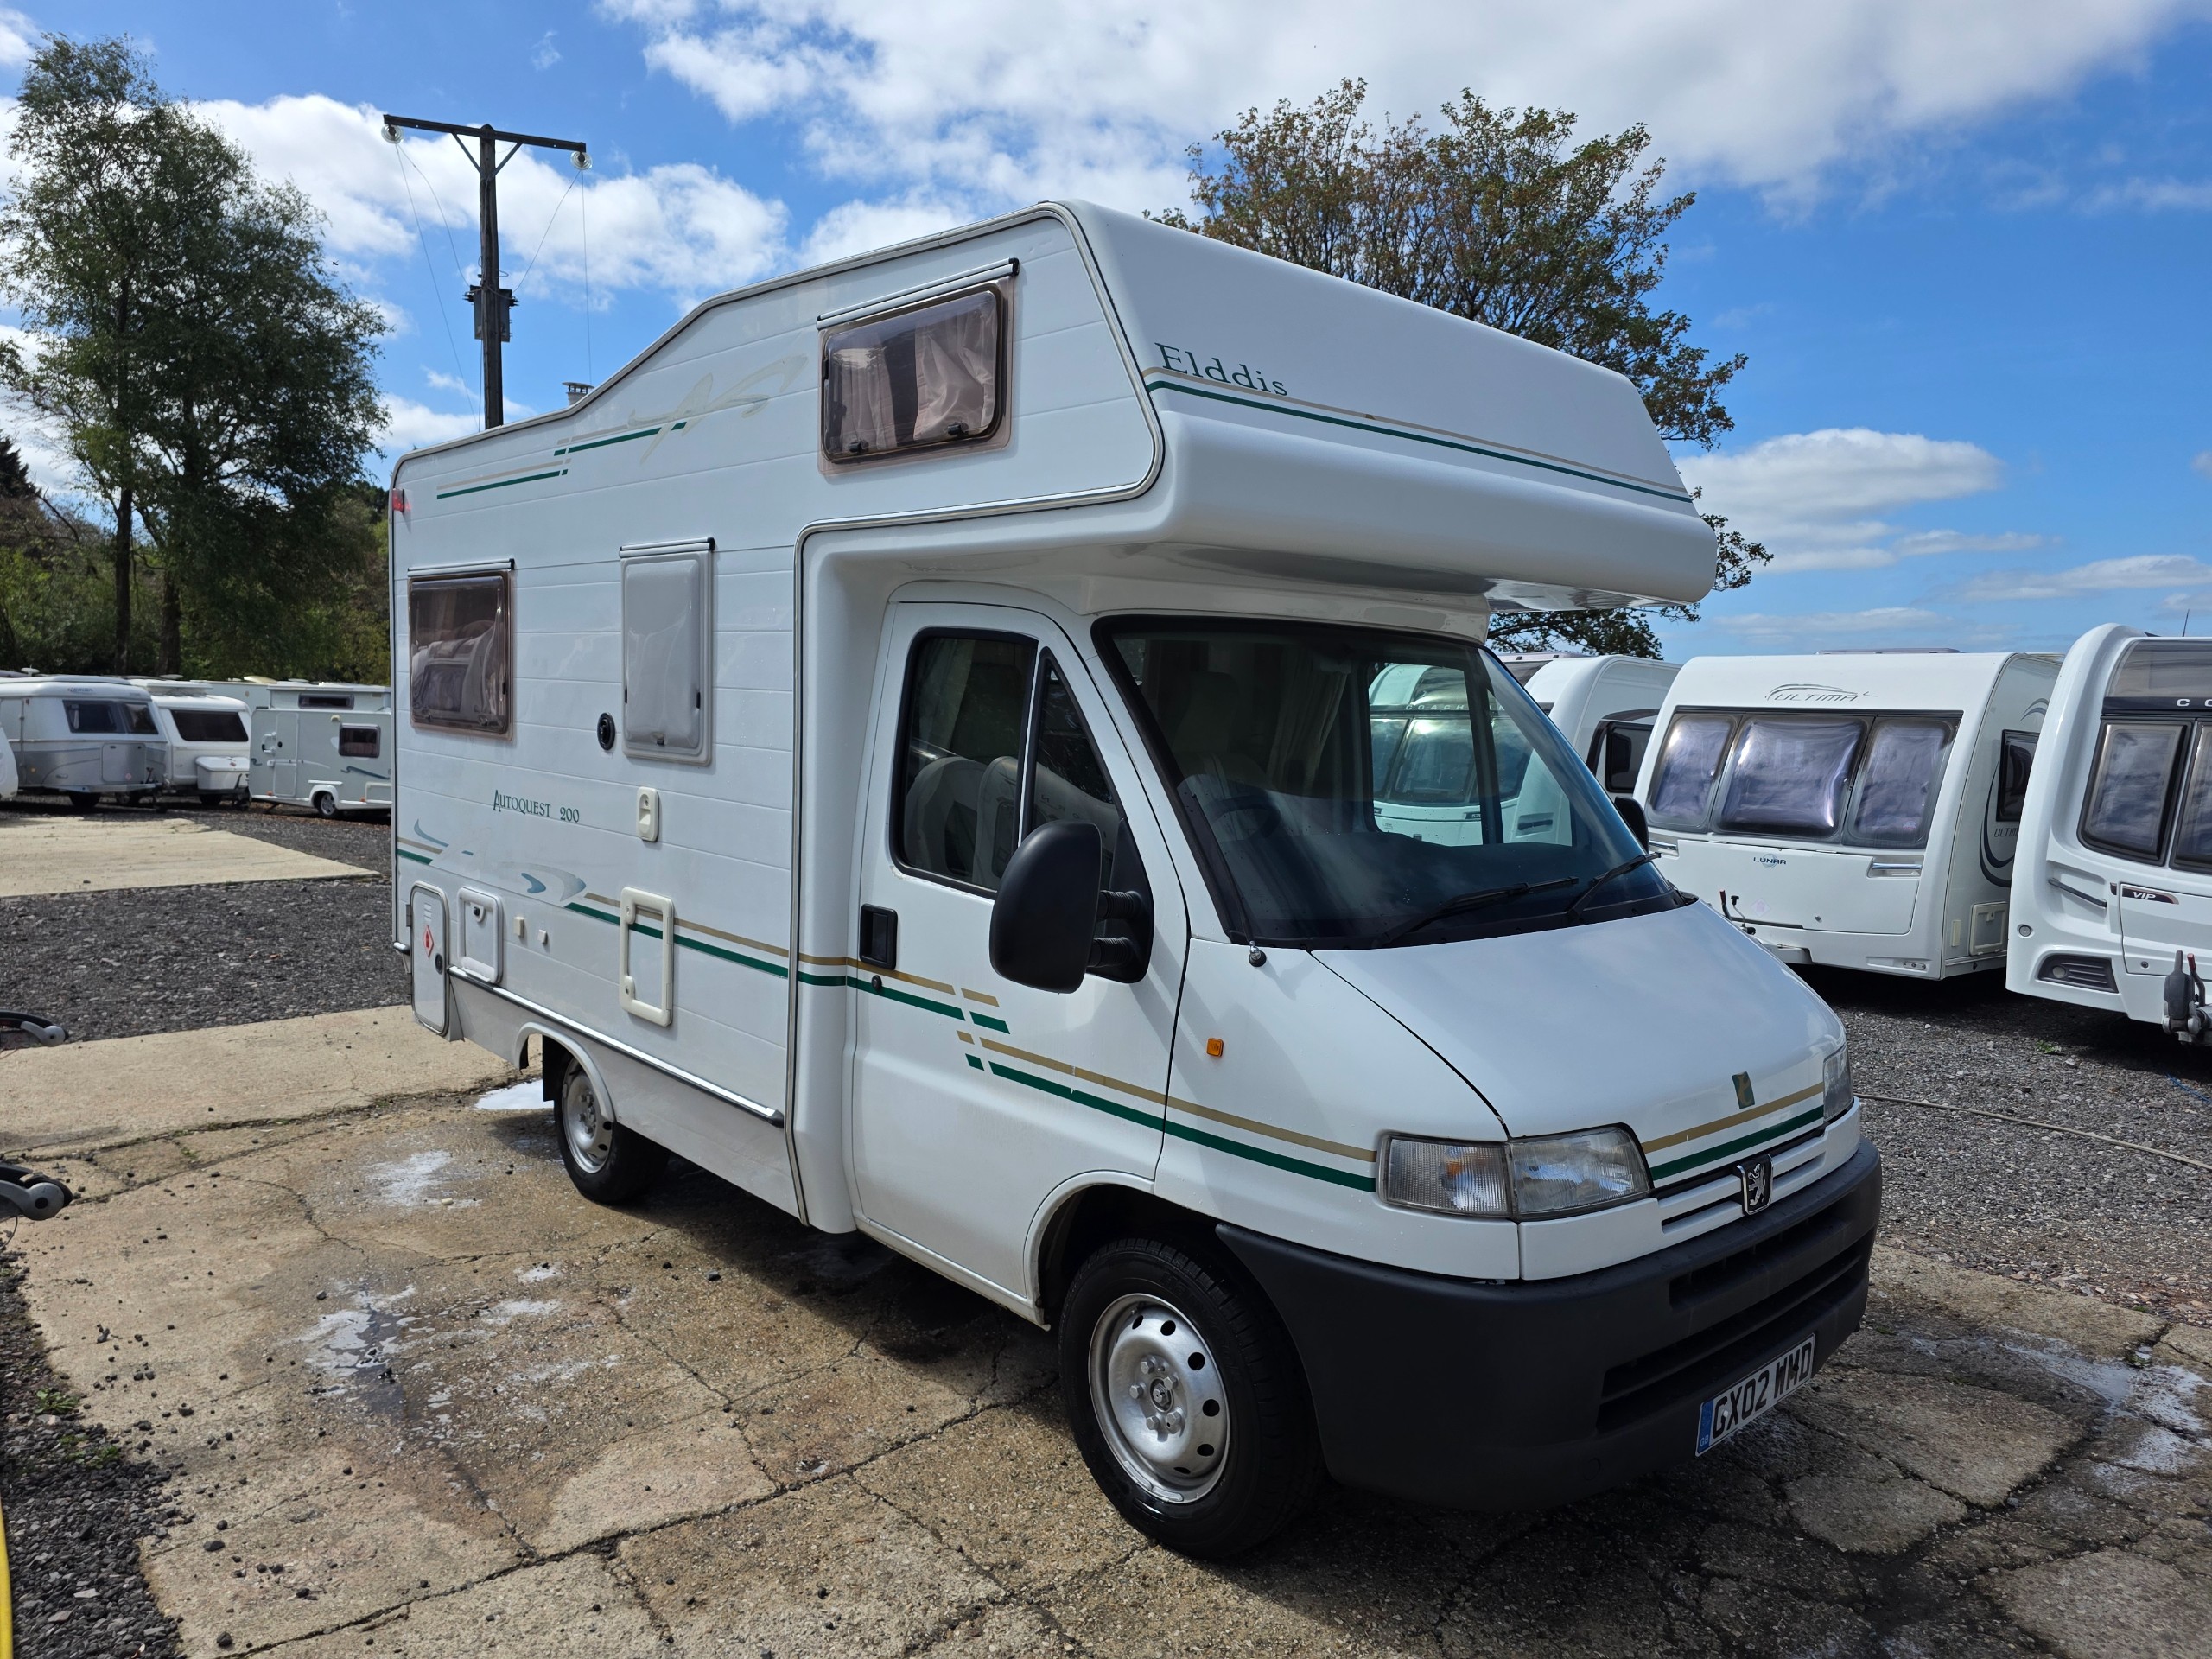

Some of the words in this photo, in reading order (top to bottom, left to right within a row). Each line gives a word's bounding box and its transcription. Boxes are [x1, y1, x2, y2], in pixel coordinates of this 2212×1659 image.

[1154, 342, 1288, 397] Elddis
[559, 806, 580, 823] 200
[1993, 827, 2019, 837] ULTIM
[1753, 856, 1787, 865] LUNAR
[2133, 891, 2156, 899] VIP
[1712, 1370, 1770, 1440] GX02
[1773, 1341, 1812, 1400] WMD
[1699, 1436, 1709, 1447] GB
